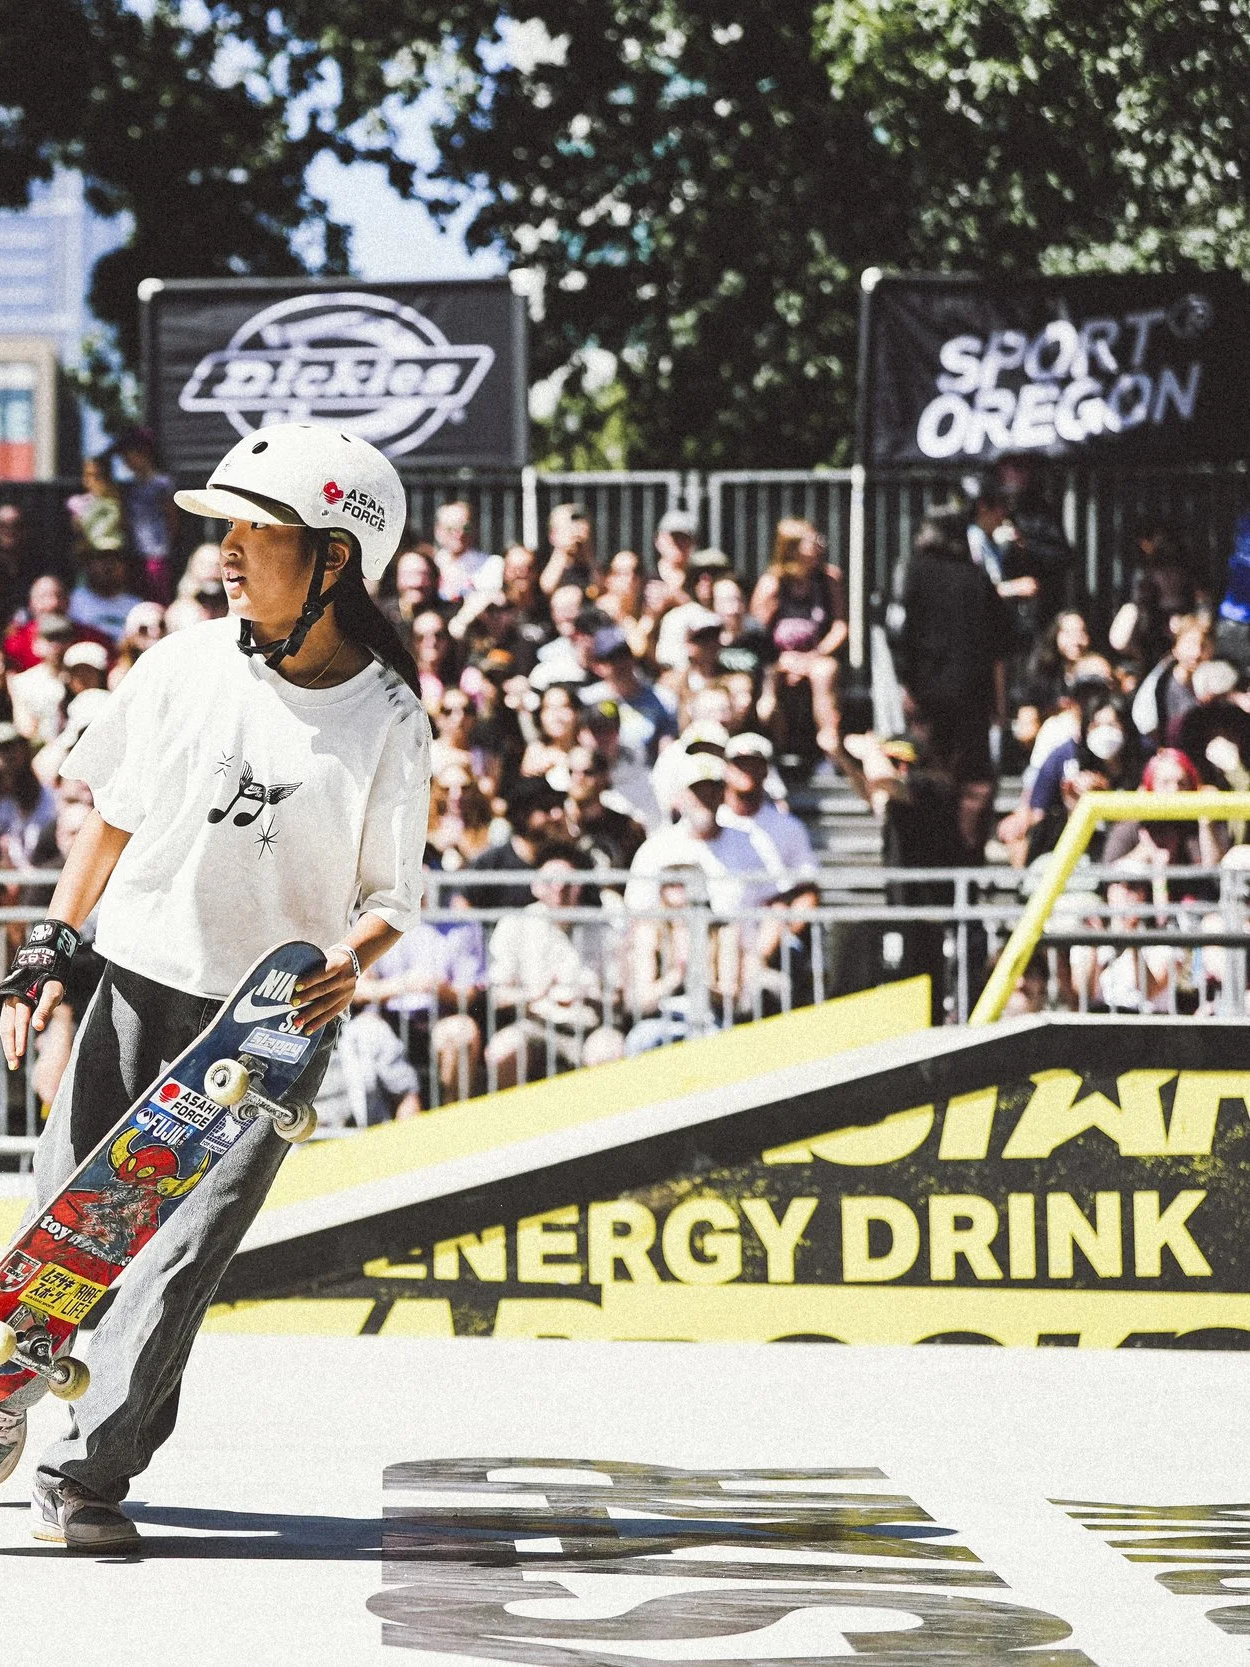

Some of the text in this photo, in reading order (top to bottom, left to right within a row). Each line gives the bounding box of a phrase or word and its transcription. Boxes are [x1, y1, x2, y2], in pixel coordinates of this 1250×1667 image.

[937, 308, 1165, 394] SPORT
[212, 356, 461, 398] Dickies
[916, 362, 1201, 458] OREGON
[342, 501, 385, 532] FORGE
[18, 953, 50, 965] 187
[254, 968, 299, 1004] NIK
[170, 1102, 211, 1129] FORGE
[180, 1091, 221, 1118] ASAHI
[39, 1215, 73, 1240] toy
[841, 1190, 1214, 1282] DRINK
[29, 1282, 66, 1304] スポーツ
[40, 1268, 76, 1292] ムラサキ
[73, 1283, 103, 1305] RIDE
[60, 1299, 90, 1319] LIFE
